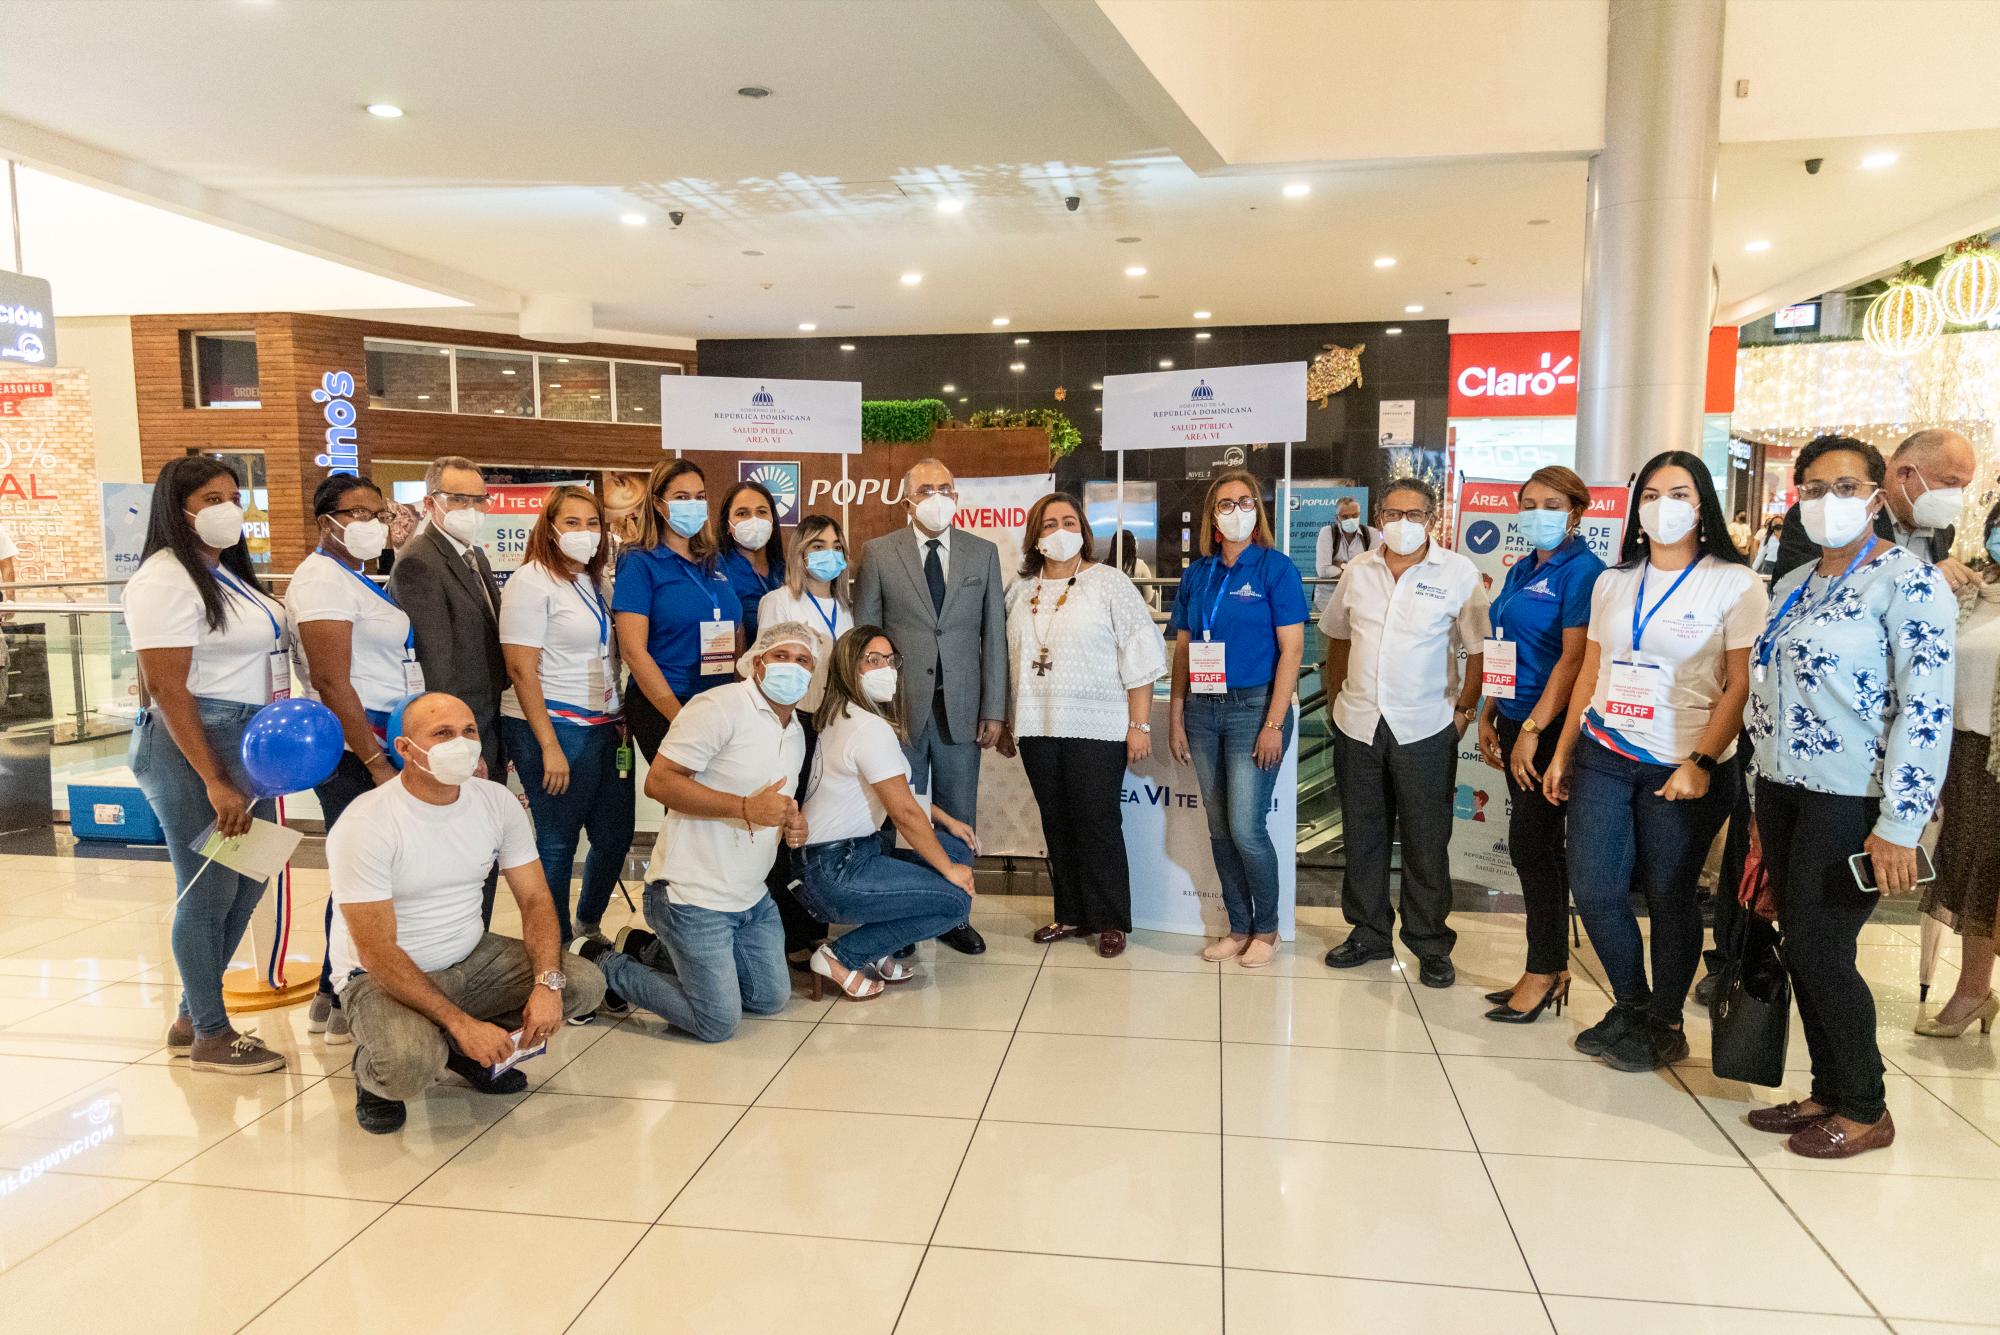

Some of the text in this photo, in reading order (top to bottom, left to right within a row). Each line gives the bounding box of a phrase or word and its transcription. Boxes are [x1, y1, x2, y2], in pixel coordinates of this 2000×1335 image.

[1457, 366, 1555, 397] Claro
[1199, 406, 1253, 416] DOMINICANA
[760, 414, 811, 422] DOMINICANA
[1171, 424, 1197, 432] SALUD
[508, 498, 526, 508] TE
[1469, 491, 1508, 507] ÁREA
[1589, 527, 1611, 537] DE
[497, 542, 528, 552] SIN
[1194, 673, 1222, 682] STAFF
[1486, 673, 1512, 685] STAFF
[1611, 703, 1648, 717] STAFF
[1144, 784, 1170, 806] VI
[1175, 793, 1198, 808] TE
